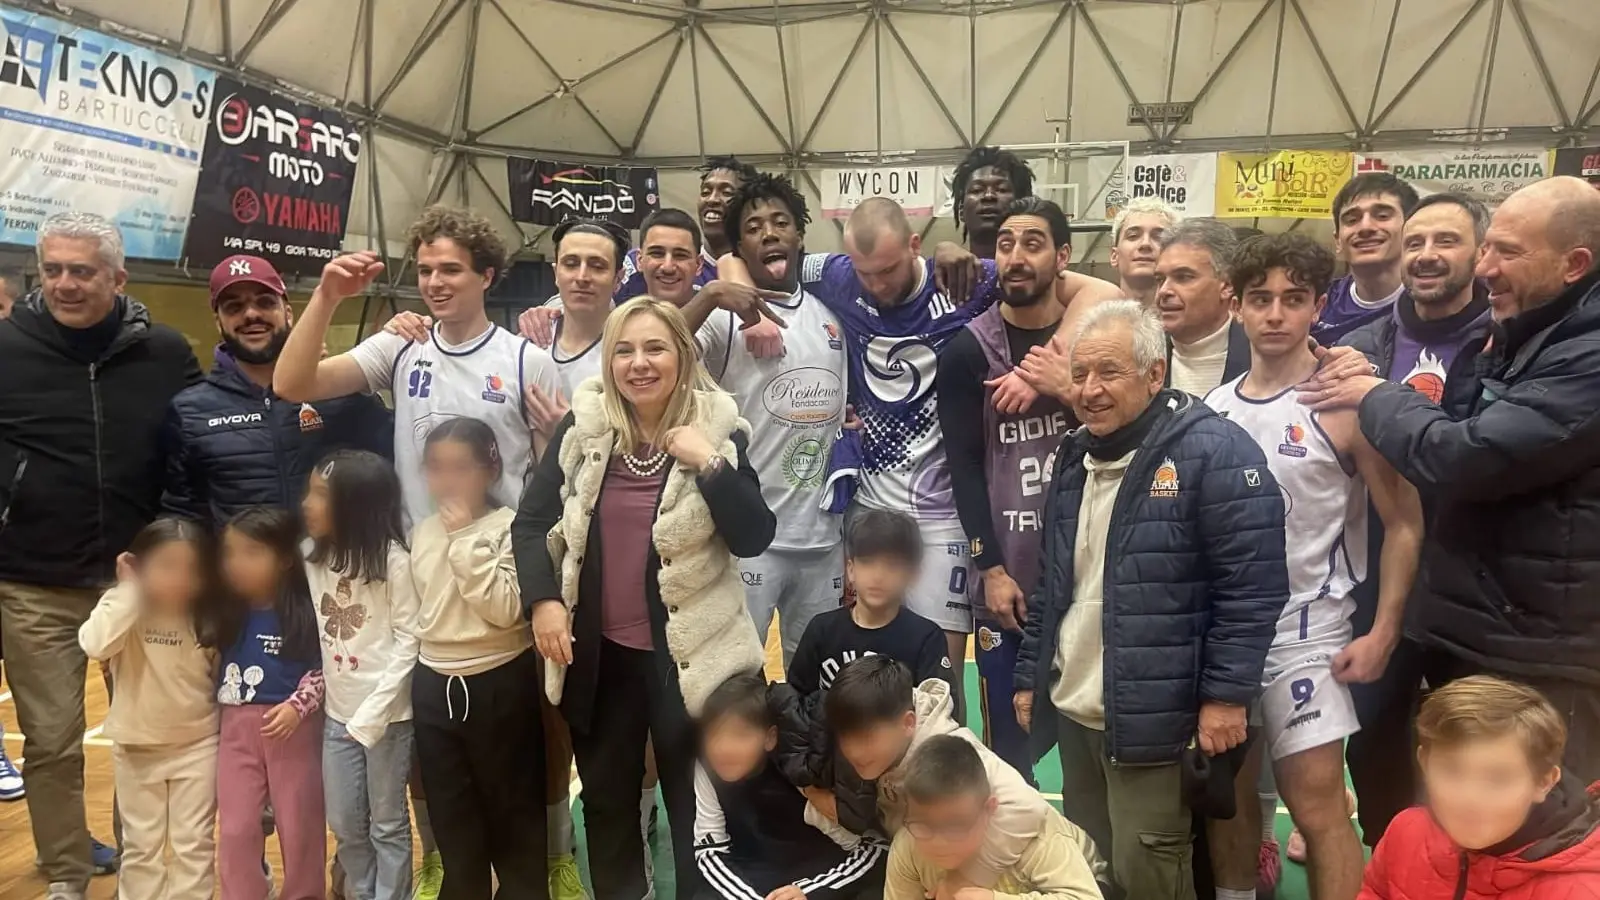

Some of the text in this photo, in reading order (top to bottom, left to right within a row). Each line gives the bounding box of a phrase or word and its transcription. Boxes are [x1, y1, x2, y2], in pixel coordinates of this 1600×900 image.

[57, 36, 209, 119] TEKNO-S
[269, 152, 324, 185] MOTO
[839, 171, 918, 195] WYCON
[1134, 165, 1171, 184] Cafè
[1235, 155, 1296, 185] Mini
[1393, 162, 1543, 181] PARAFARMACIA
[263, 192, 341, 235] YAMAHA
[224, 237, 242, 248] VIA
[266, 242, 280, 253] 49
[408, 369, 433, 398] 92
[208, 413, 261, 427] GIVOVA
[1291, 677, 1314, 711] 9
